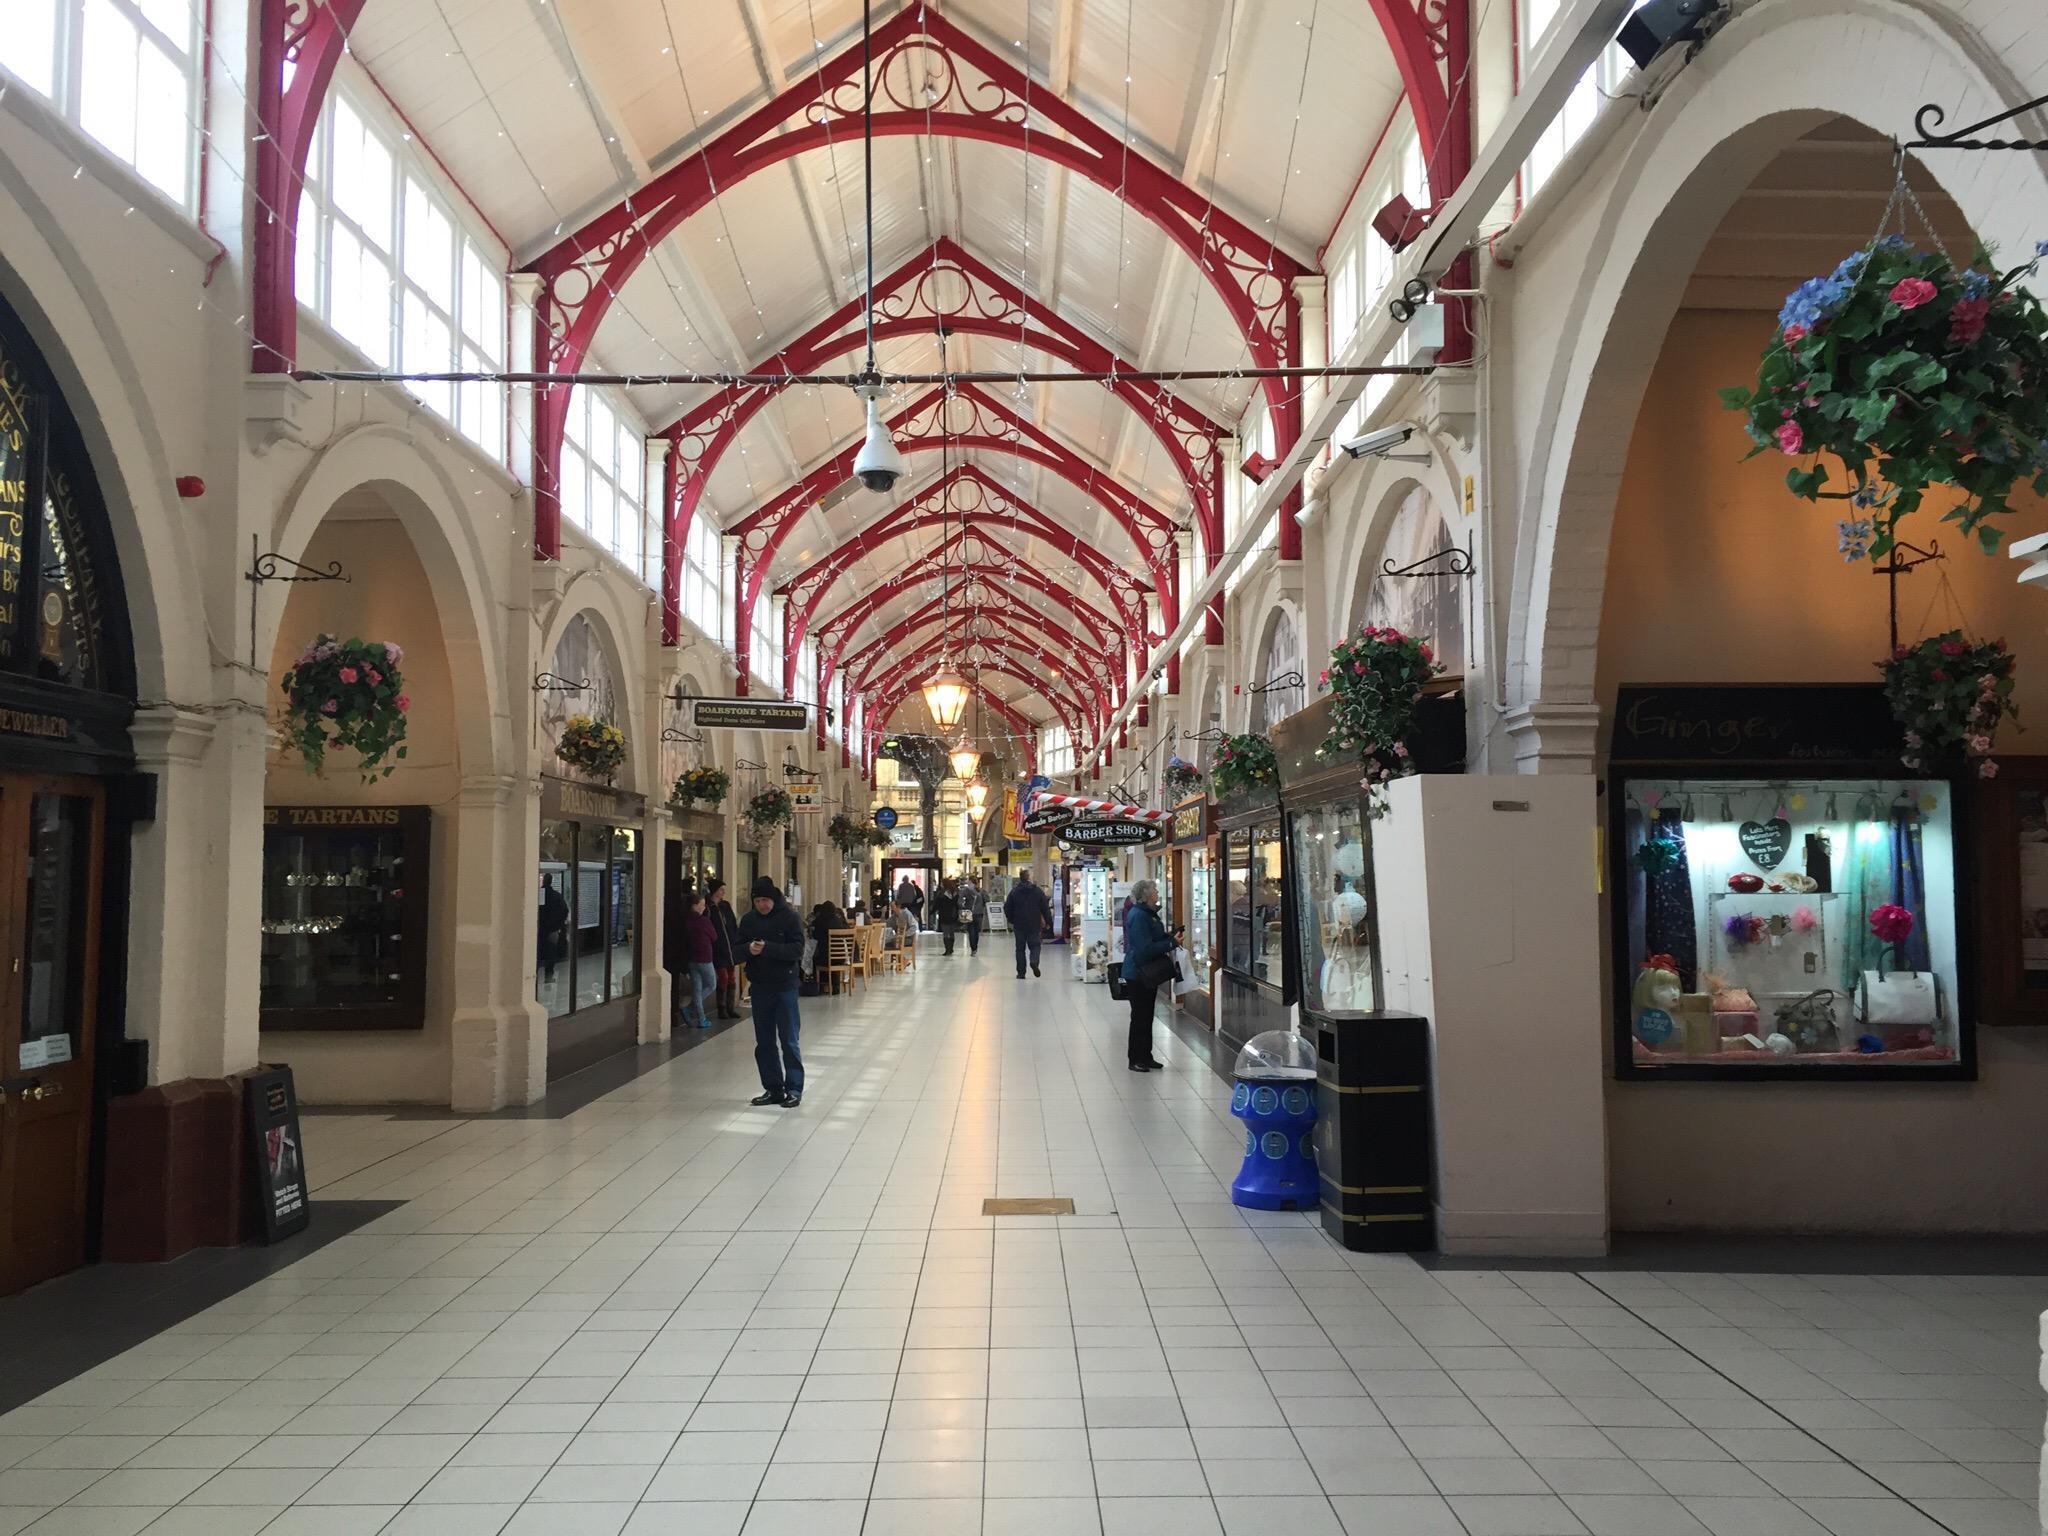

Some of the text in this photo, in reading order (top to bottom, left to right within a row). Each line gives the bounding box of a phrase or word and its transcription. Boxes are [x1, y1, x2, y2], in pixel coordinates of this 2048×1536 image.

[698, 706, 805, 717] BOARSTONE TARTANS
[1625, 695, 1794, 755] Ginger
[289, 808, 400, 824] TARTANS
[1065, 826, 1113, 839] BARBER
[1116, 825, 1146, 836] SHOP
[1759, 854, 1770, 863] £8
